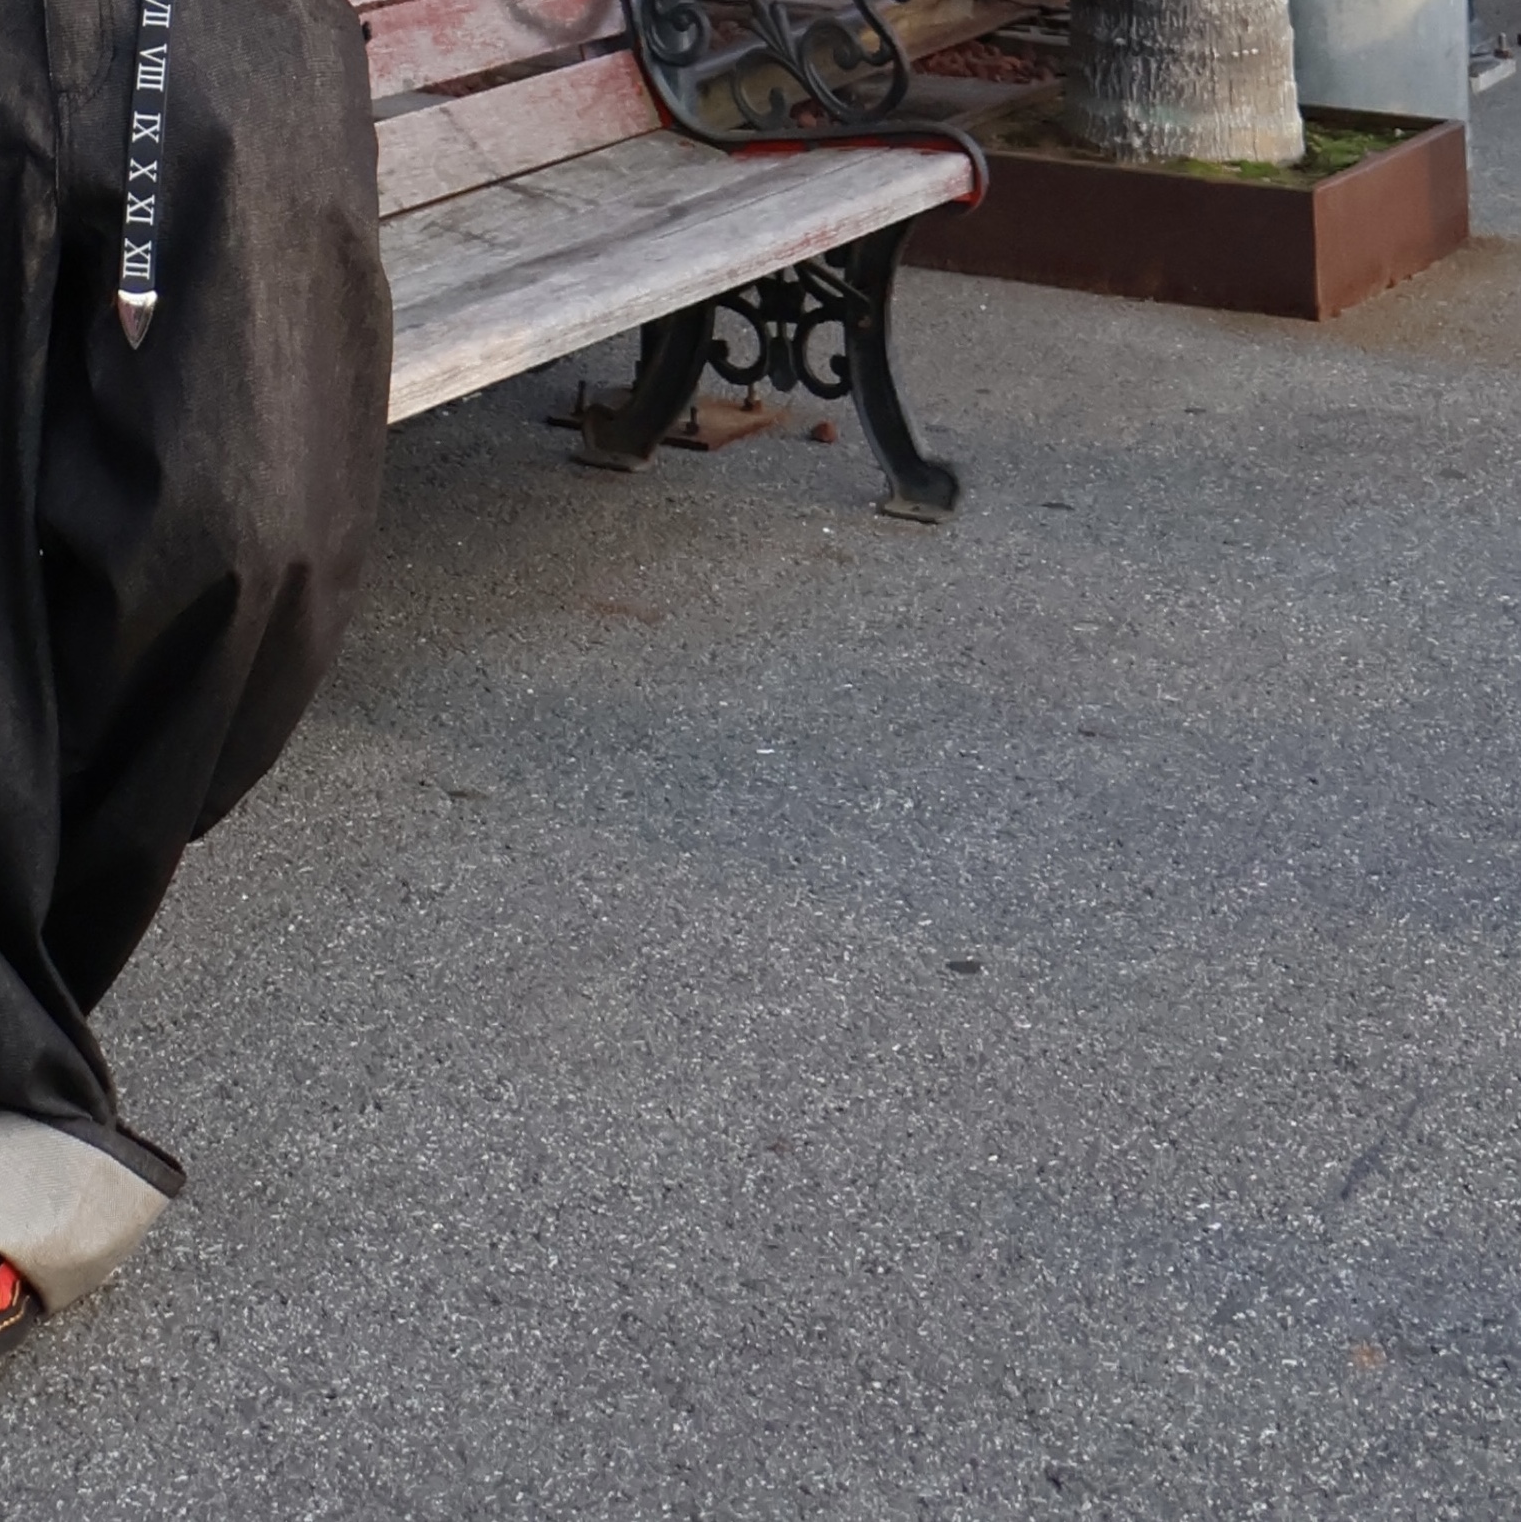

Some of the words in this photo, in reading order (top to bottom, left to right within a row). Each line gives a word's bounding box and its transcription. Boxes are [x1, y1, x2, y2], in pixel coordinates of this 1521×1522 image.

[136, 43, 167, 92] VIII
[132, 111, 161, 144] IX
[129, 158, 157, 183] X
[126, 191, 155, 226] XI
[122, 238, 152, 280] XII
